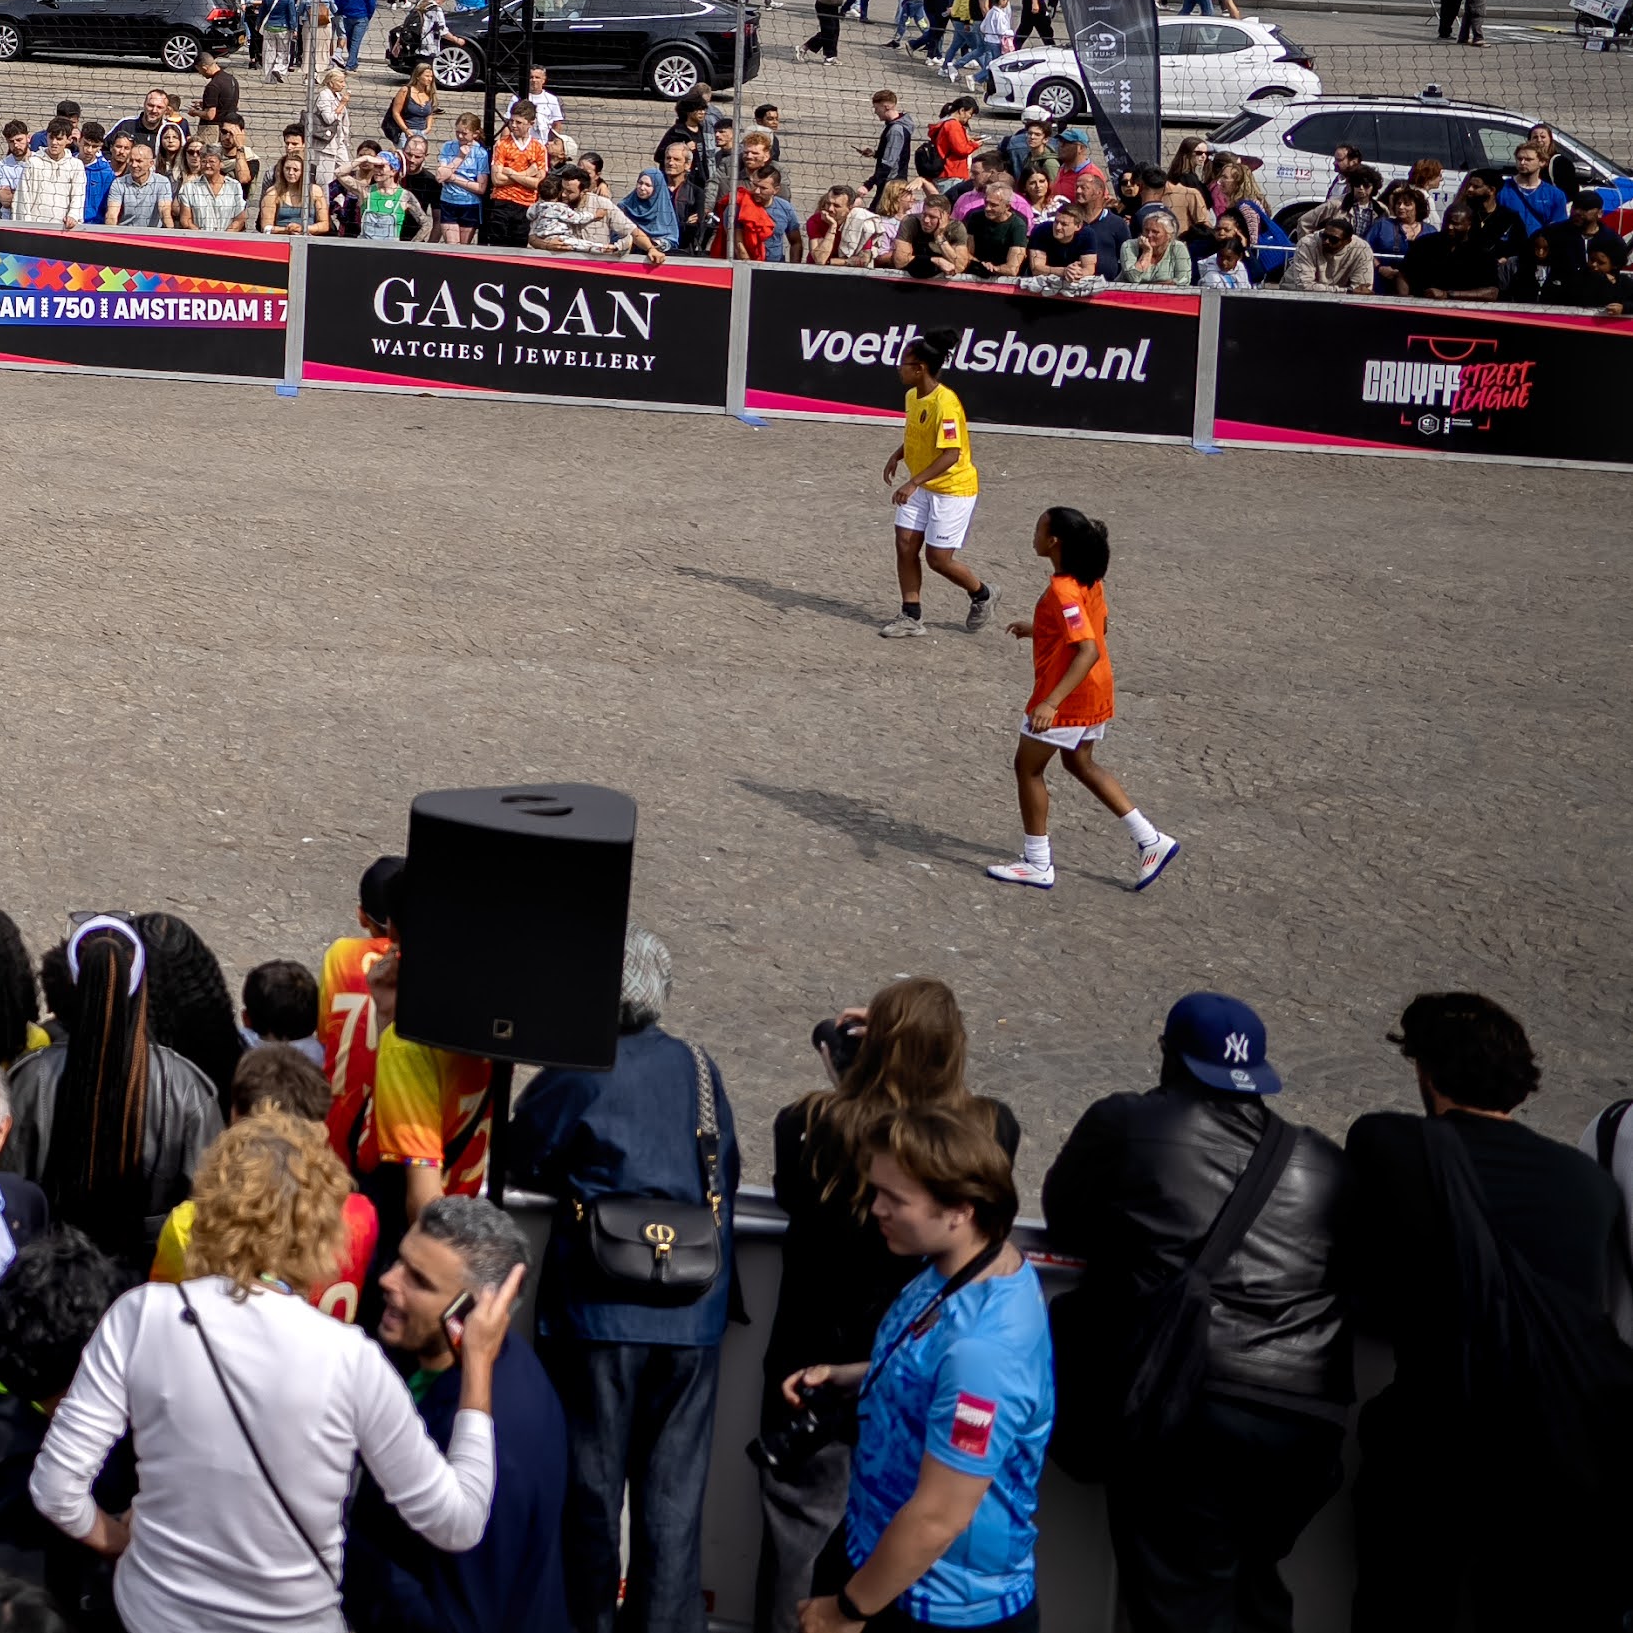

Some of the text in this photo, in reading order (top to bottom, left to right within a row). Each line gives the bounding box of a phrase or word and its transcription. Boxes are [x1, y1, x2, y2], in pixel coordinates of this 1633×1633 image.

[53, 297, 97, 322] 750
[113, 296, 260, 323] AMSTERDAM
[373, 275, 661, 341] GASSAN
[371, 337, 658, 372] WATCHES JEWELLERY
[800, 323, 1151, 390] voetlshop.nl
[1361, 359, 1536, 407] CRUYFF STREET
[1451, 384, 1531, 415] LEAGUE
[1223, 1031, 1250, 1064] NY
